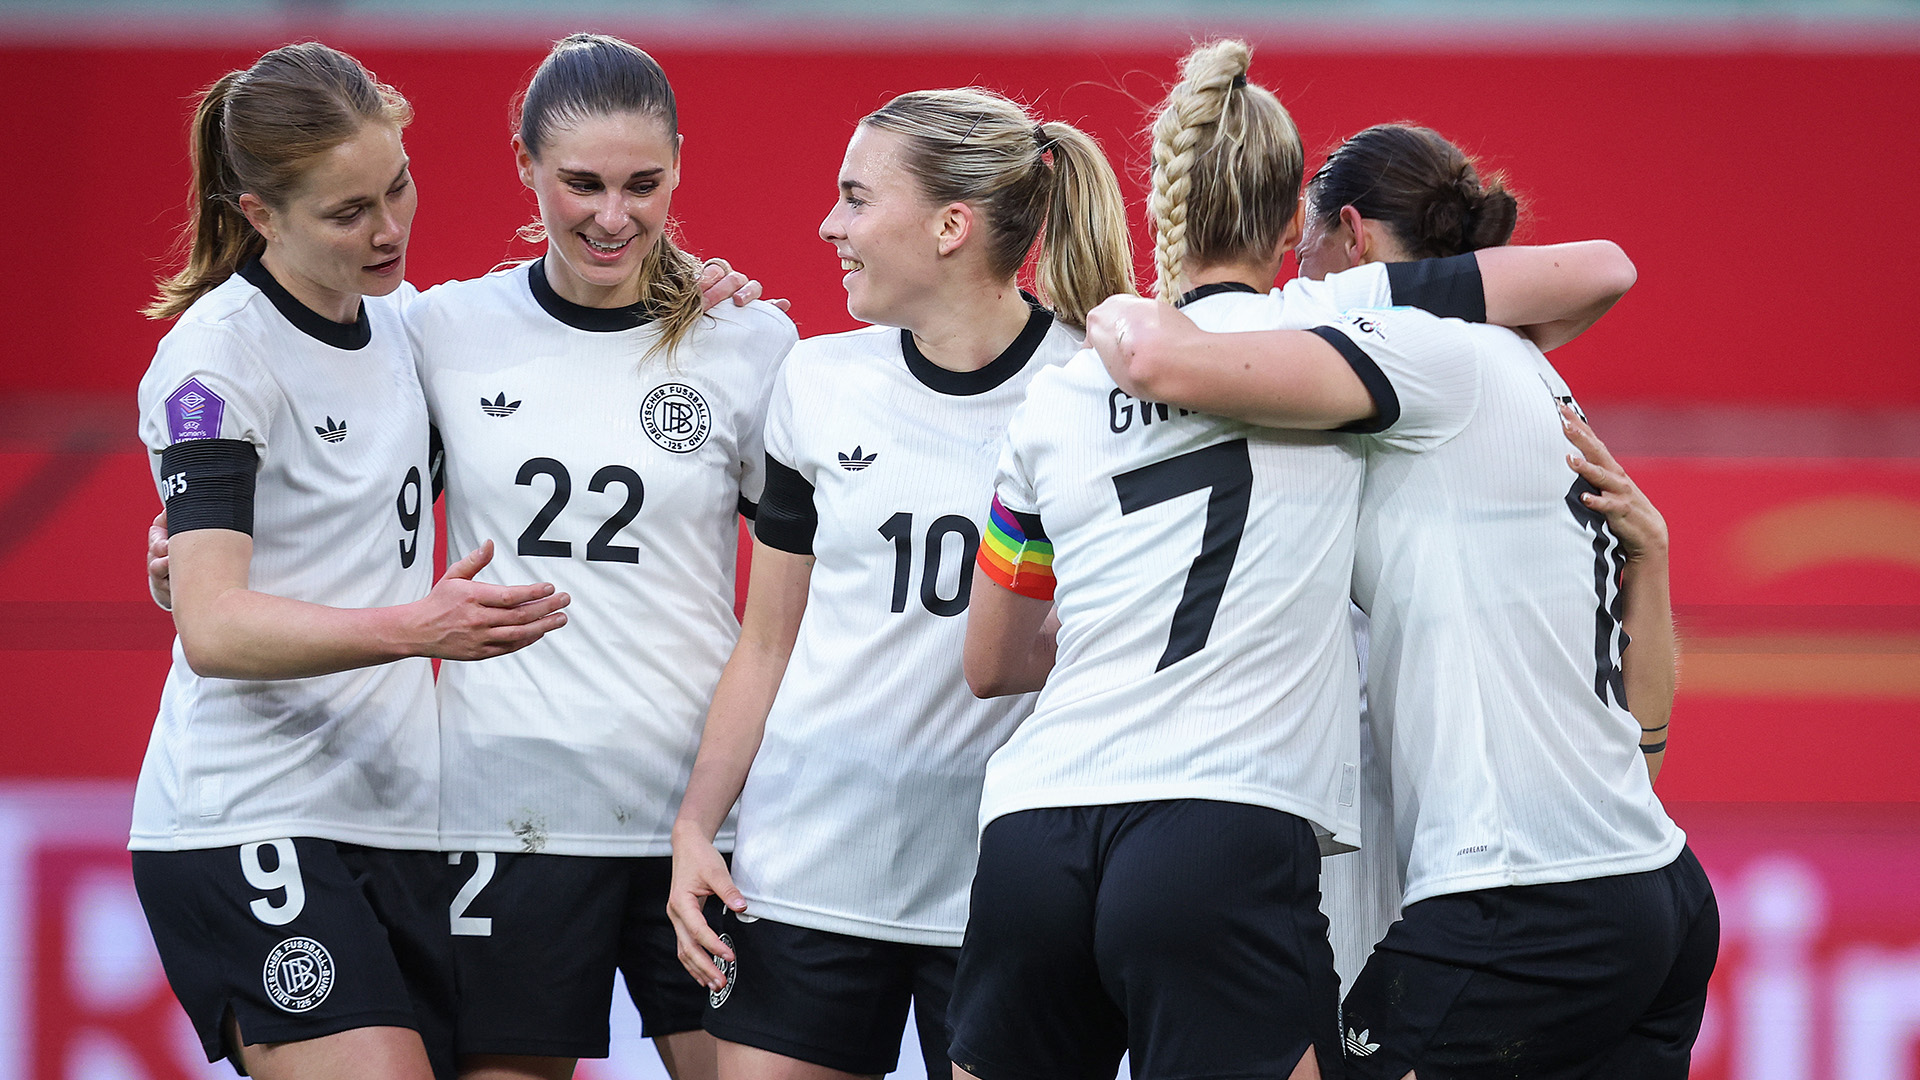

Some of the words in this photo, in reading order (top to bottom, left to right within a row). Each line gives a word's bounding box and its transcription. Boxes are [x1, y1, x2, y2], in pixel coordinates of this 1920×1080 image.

[644, 388, 667, 441] DEUTSCHER
[1109, 387, 1198, 434] GW
[397, 466, 421, 569] 9
[515, 457, 645, 564] 22
[1112, 437, 1253, 674] 7
[878, 512, 981, 617] 10
[239, 837, 306, 926] 9
[267, 949, 291, 1006] DEUTSCHER
